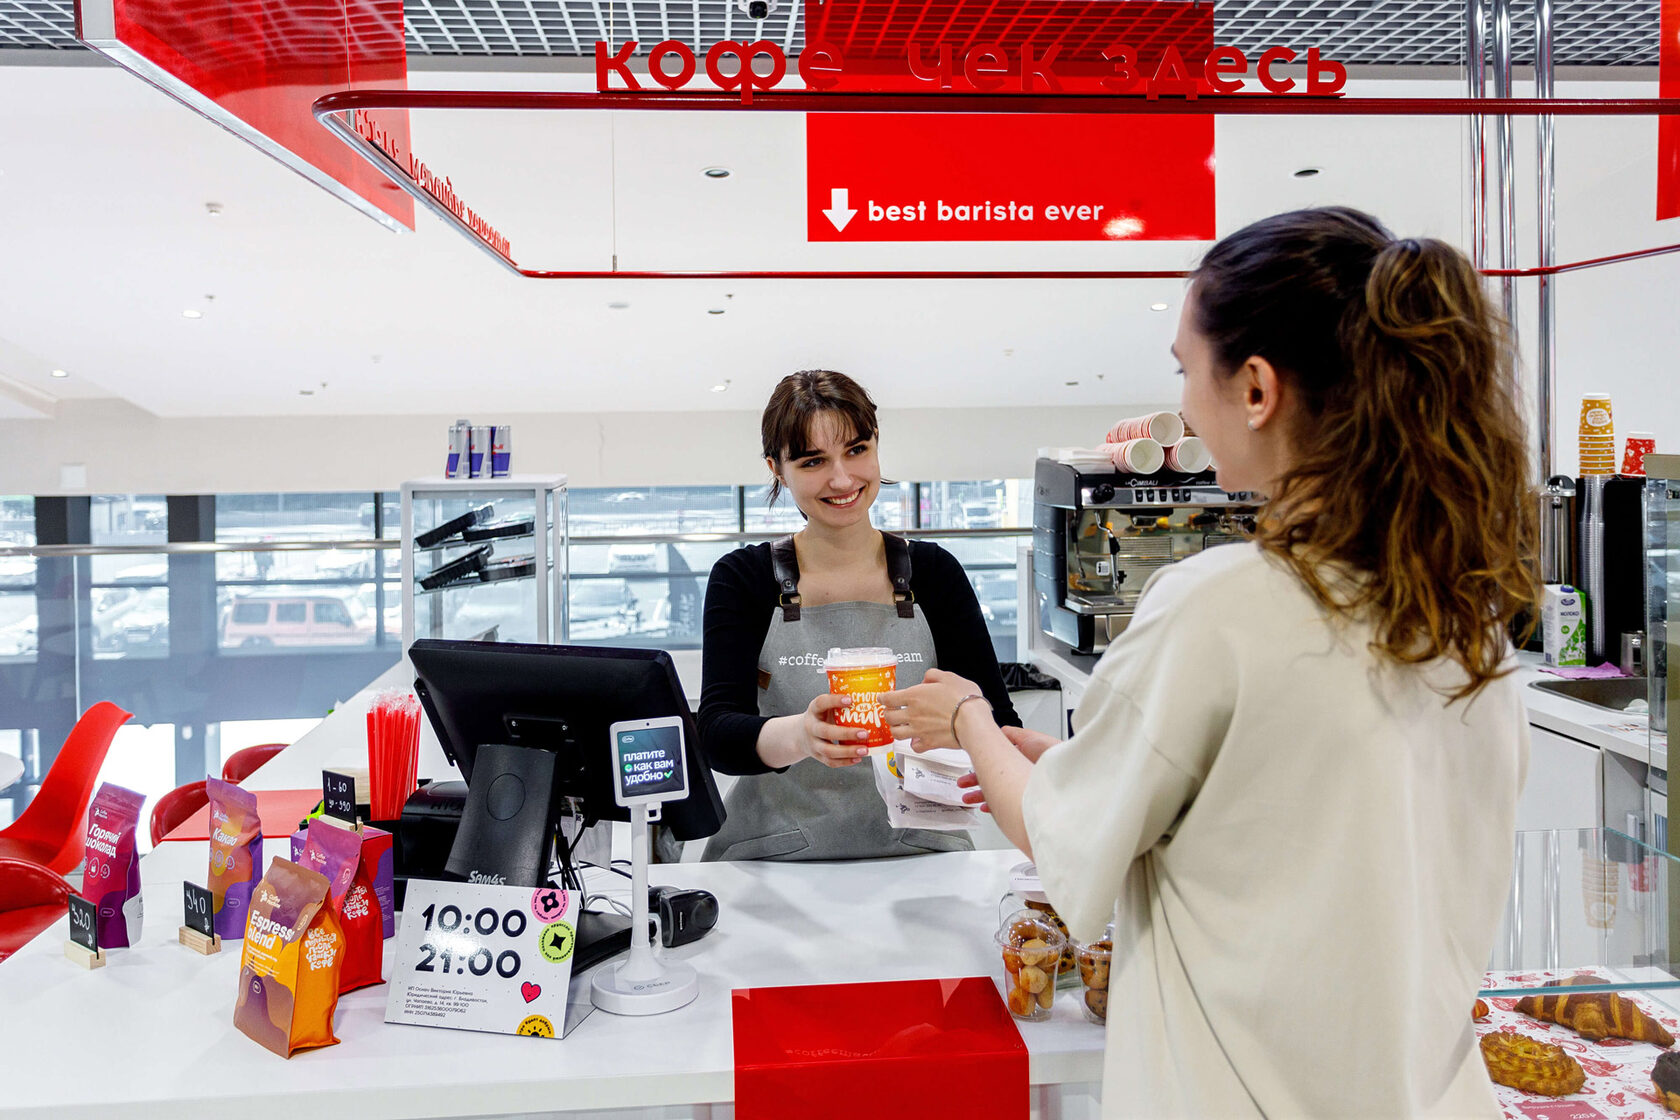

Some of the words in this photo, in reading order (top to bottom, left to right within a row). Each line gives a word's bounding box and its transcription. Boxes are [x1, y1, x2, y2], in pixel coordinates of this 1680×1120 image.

[595, 39, 844, 105] кофе
[907, 42, 1063, 92] чек
[1100, 44, 1348, 101] здесь
[868, 200, 927, 222] best
[937, 200, 1034, 222] barista
[1045, 203, 1105, 221] ever
[623, 749, 666, 762] платите
[633, 762, 653, 772] как
[654, 760, 674, 769] вам
[624, 770, 664, 786] удобно
[89, 823, 121, 845] Горячий
[212, 827, 238, 848] Какао
[85, 836, 117, 859] шоколад
[422, 904, 527, 938] 10:00
[247, 925, 277, 950] blend
[414, 943, 522, 979] 21:00
